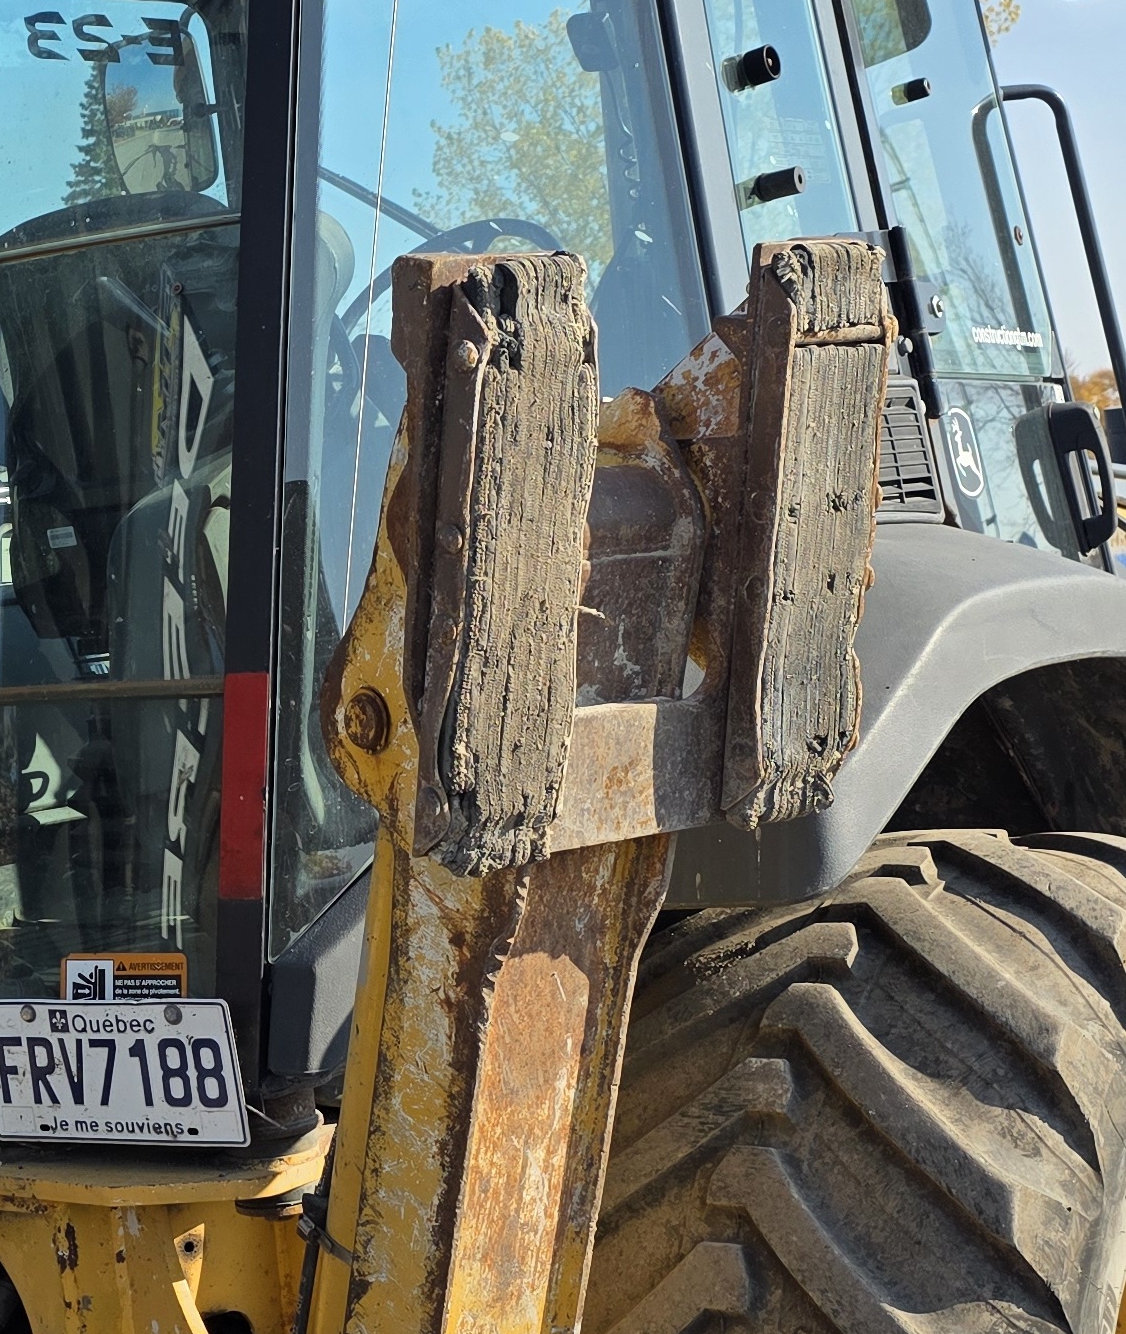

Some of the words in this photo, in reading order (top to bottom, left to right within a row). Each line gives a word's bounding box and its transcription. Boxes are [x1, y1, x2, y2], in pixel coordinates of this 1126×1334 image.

[128, 962, 184, 971] AVERTISSEMENT
[71, 1013, 155, 1034] Québec
[51, 1116, 69, 1134] Je
[75, 1120, 99, 1133] me
[106, 1118, 185, 1135] souviens
